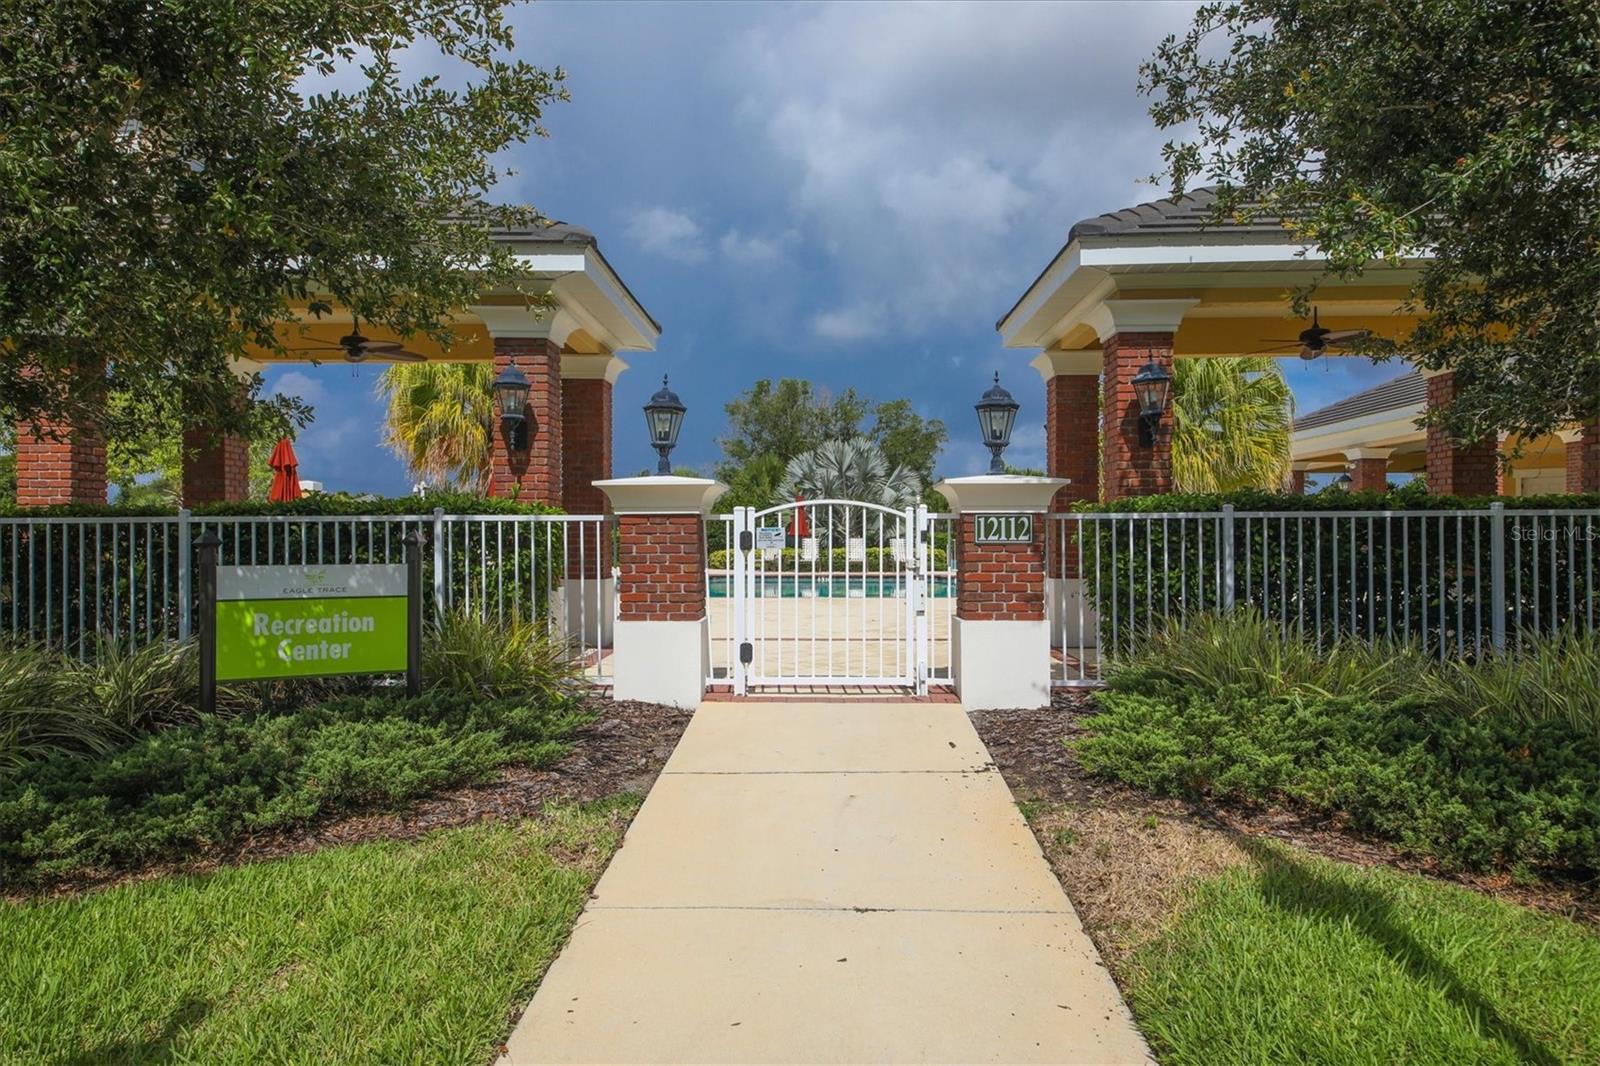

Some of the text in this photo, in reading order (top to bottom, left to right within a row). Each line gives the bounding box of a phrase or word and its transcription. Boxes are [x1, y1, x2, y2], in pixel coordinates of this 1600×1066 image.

[978, 517, 1029, 540] 12112
[254, 611, 375, 636] Recreation
[278, 639, 352, 661] Center
